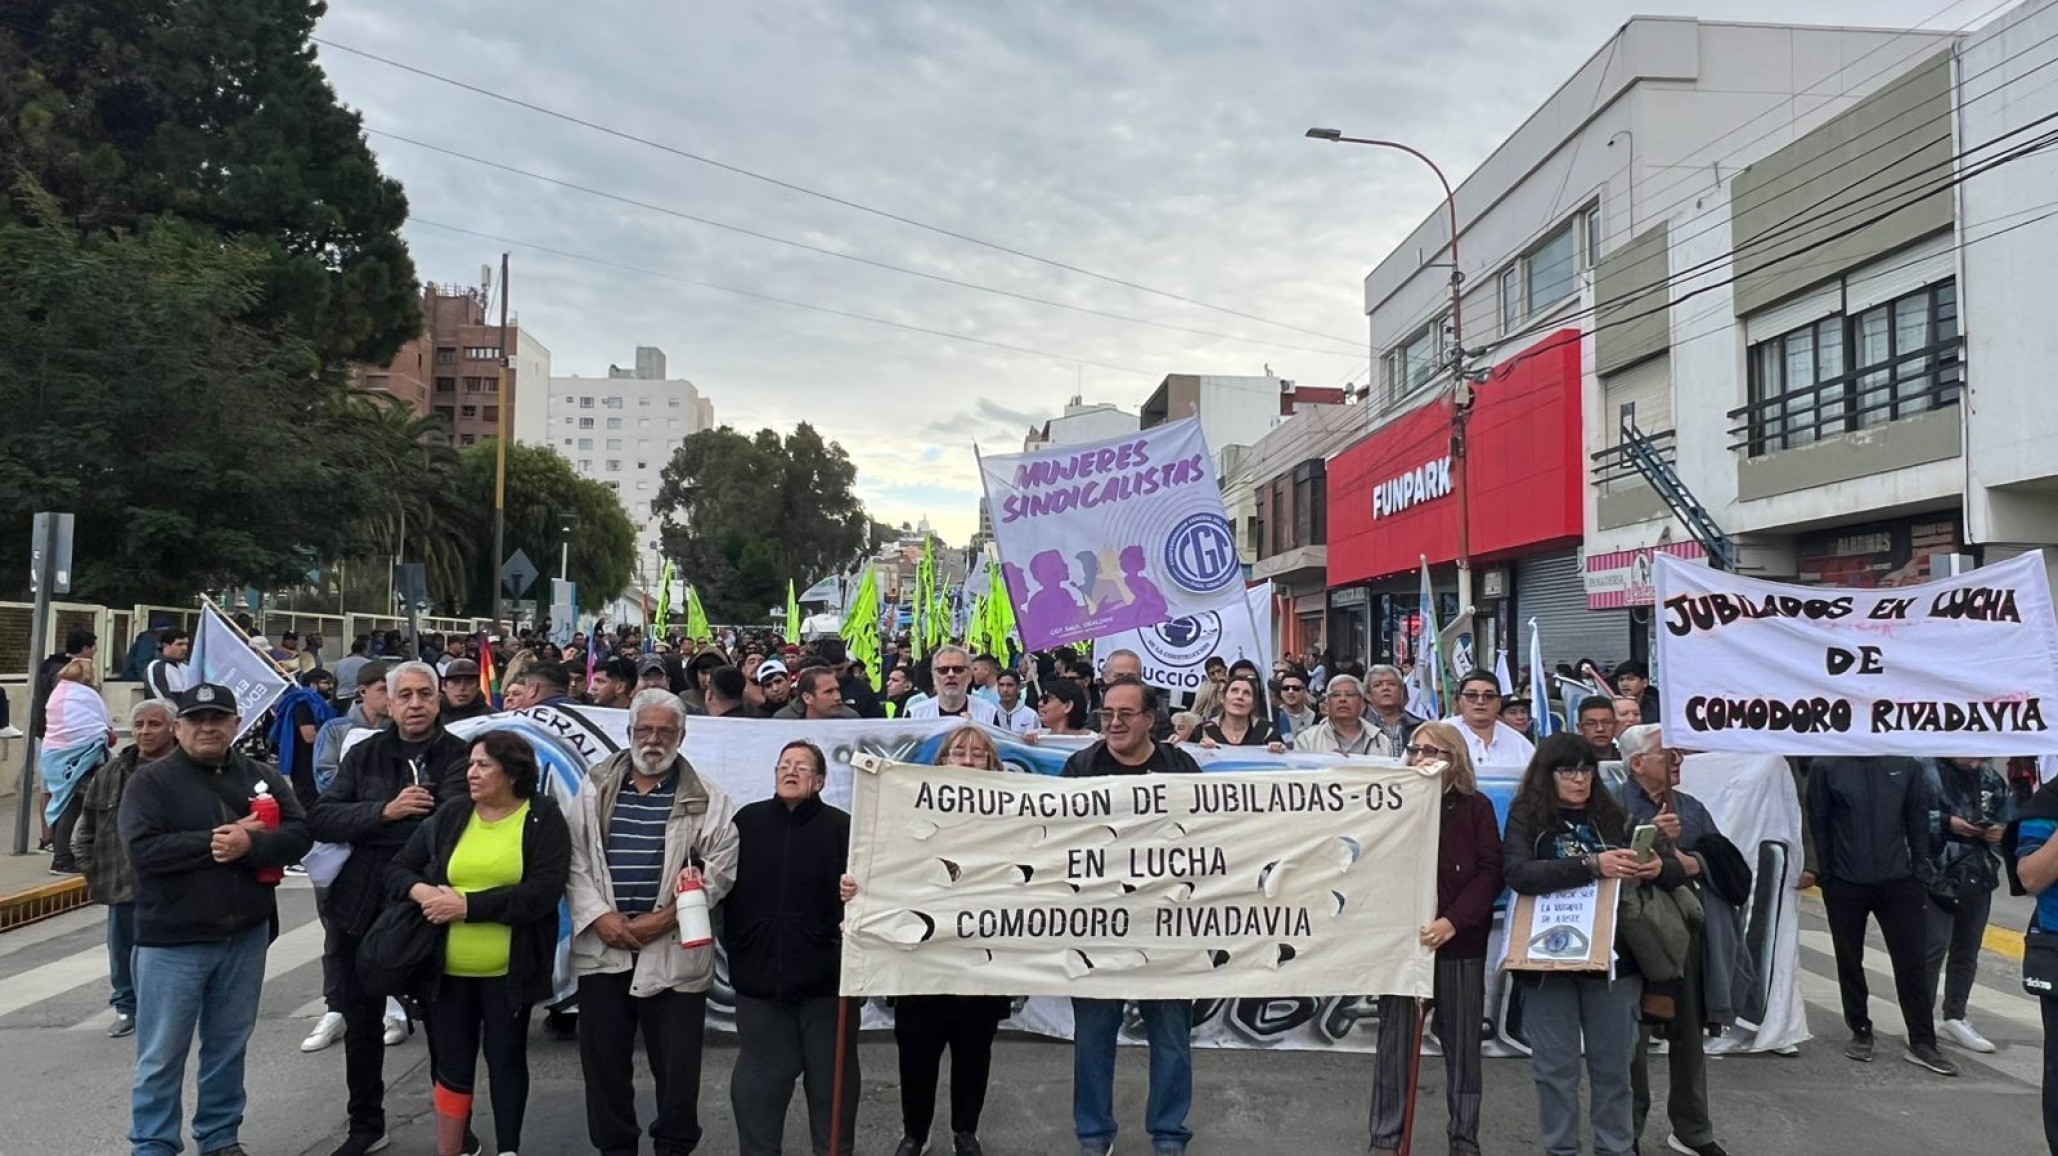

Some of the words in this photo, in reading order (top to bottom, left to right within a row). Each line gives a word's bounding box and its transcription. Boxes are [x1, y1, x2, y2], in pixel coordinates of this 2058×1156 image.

[1017, 439, 1150, 489] MUJERES
[1002, 454, 1205, 523] SINDICALISTAS
[1373, 456, 1451, 520] FUNPARK
[1179, 525, 1229, 579] CGT
[1664, 593, 1853, 636] JUBILADOS
[1868, 597, 1918, 620] EN
[1928, 587, 2022, 623] LUCHA
[1826, 645, 1884, 675] DE
[1686, 696, 1851, 733] COMODORO
[1871, 698, 2048, 733] RIVADAVIA
[915, 781, 1111, 817] AGRUPACION
[1133, 784, 1168, 814] DE
[1189, 782, 1403, 813] JUBILADAS-OS
[1068, 849, 1105, 878] EN
[1130, 847, 1227, 878] LUCHA
[956, 906, 1129, 938] COMODORO
[1155, 906, 1311, 937] RIVADAVIA
